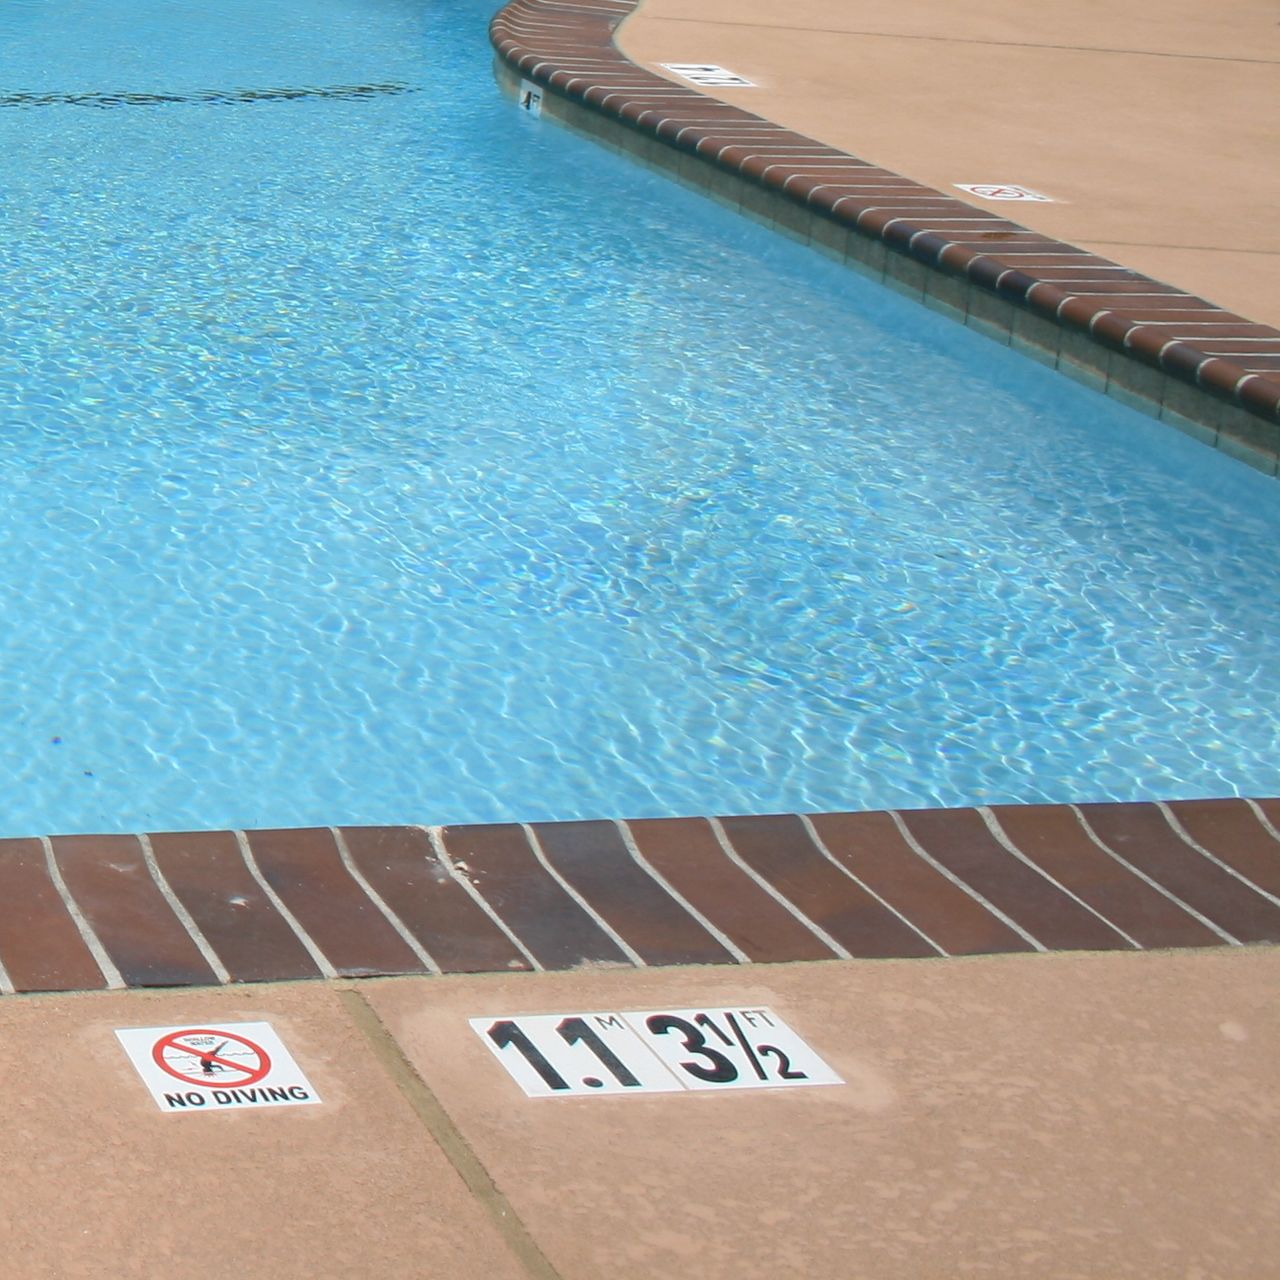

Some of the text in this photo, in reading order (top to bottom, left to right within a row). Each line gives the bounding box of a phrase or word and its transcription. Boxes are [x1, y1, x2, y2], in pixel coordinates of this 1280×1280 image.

[487, 1017, 642, 1089] 1.1
[594, 1015, 624, 1030] M
[739, 1010, 776, 1028] FT
[163, 1085, 308, 1107] NO DIVING
